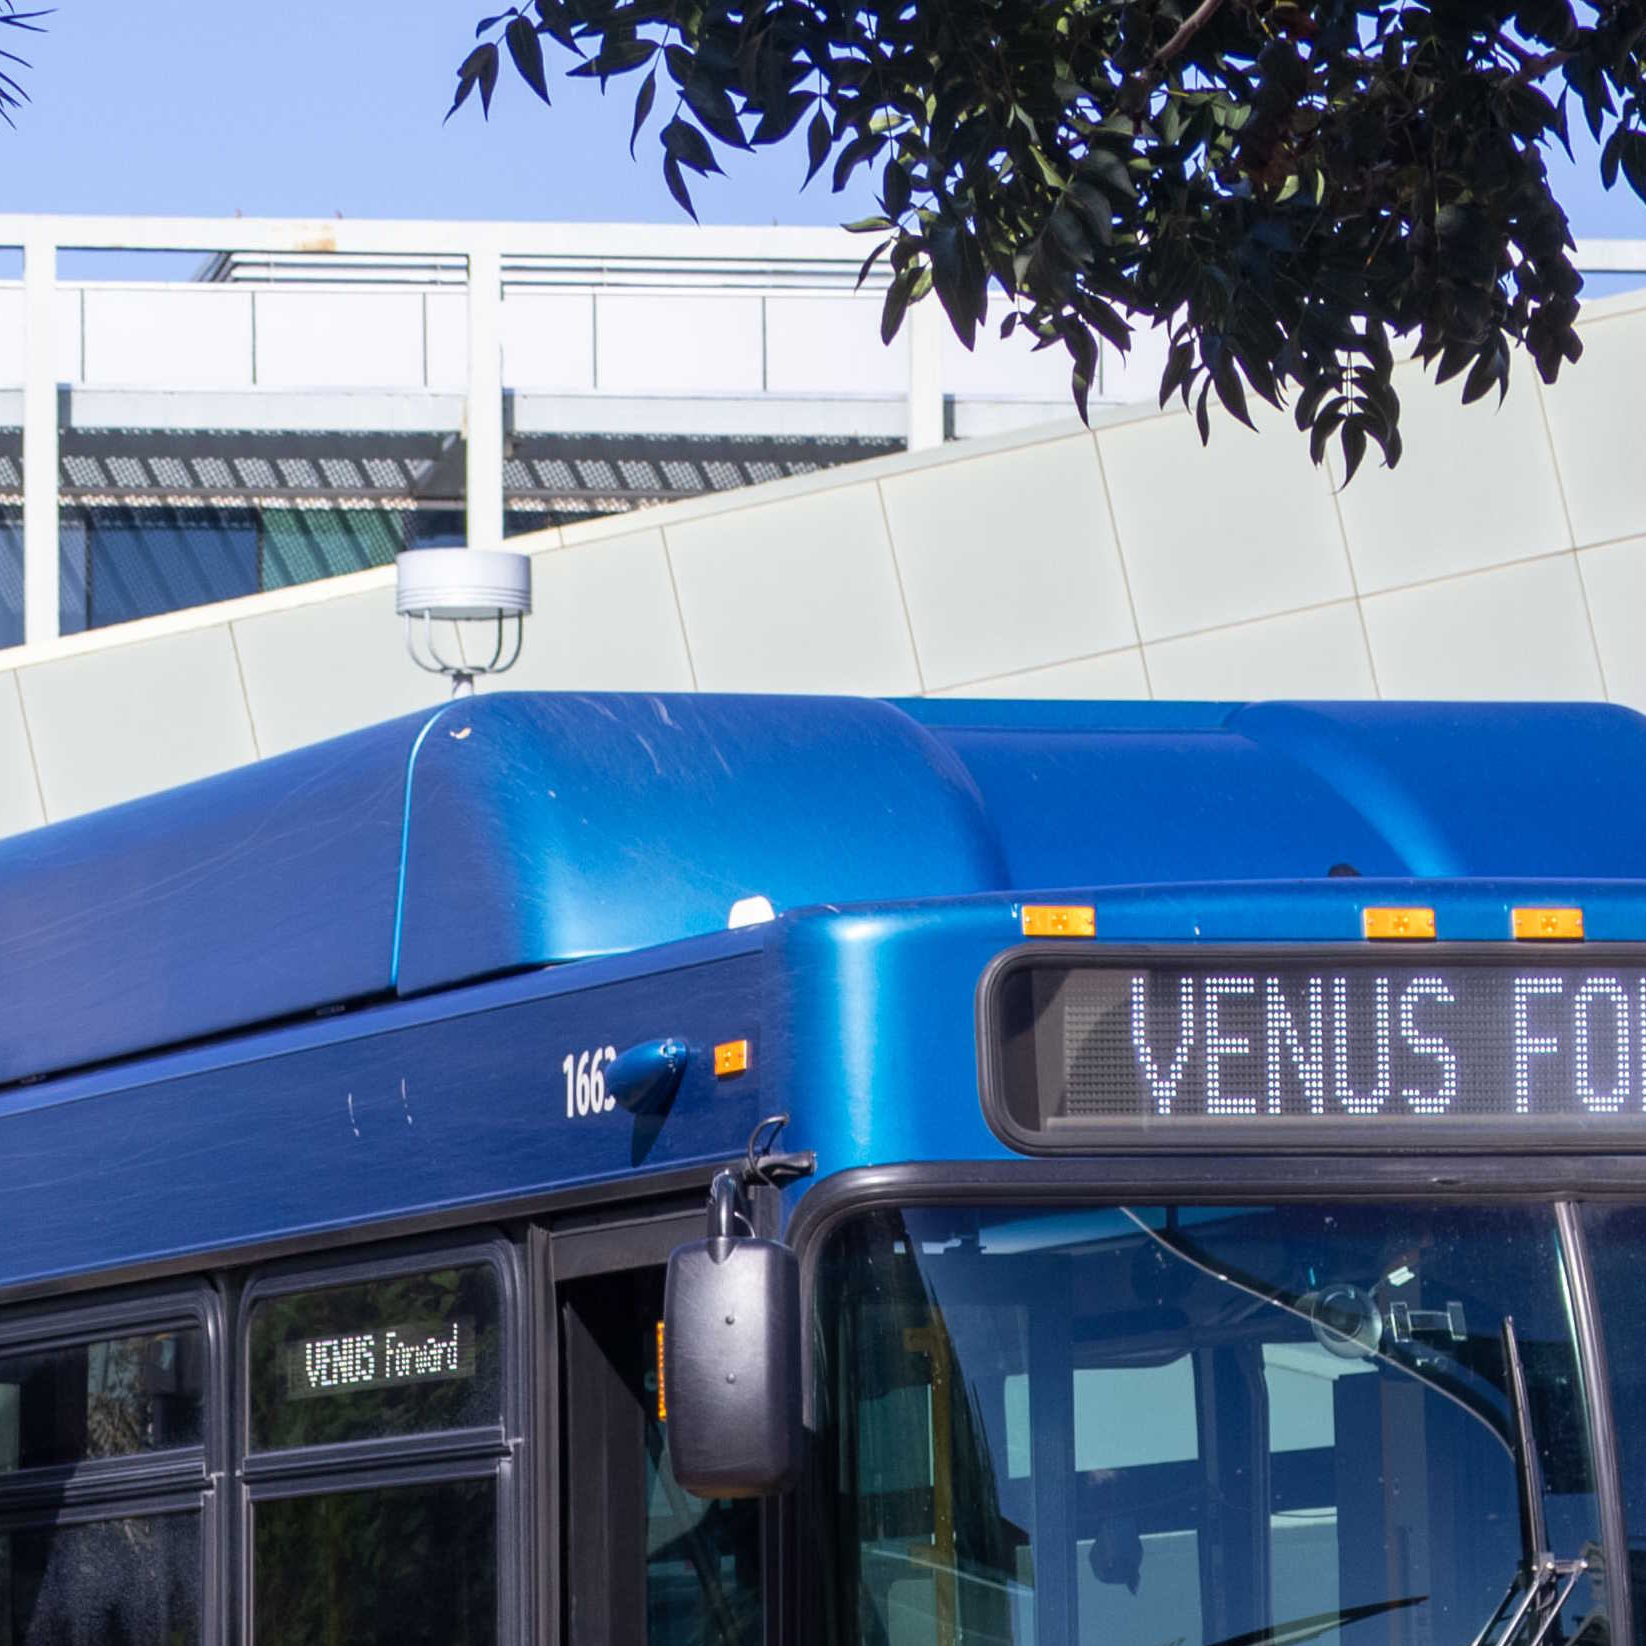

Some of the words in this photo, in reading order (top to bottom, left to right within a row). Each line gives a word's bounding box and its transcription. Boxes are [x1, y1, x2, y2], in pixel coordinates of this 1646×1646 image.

[1131, 976, 1458, 1117] VENUS
[305, 1334, 375, 1388] VENUS
[385, 1322, 458, 1379] Forward
